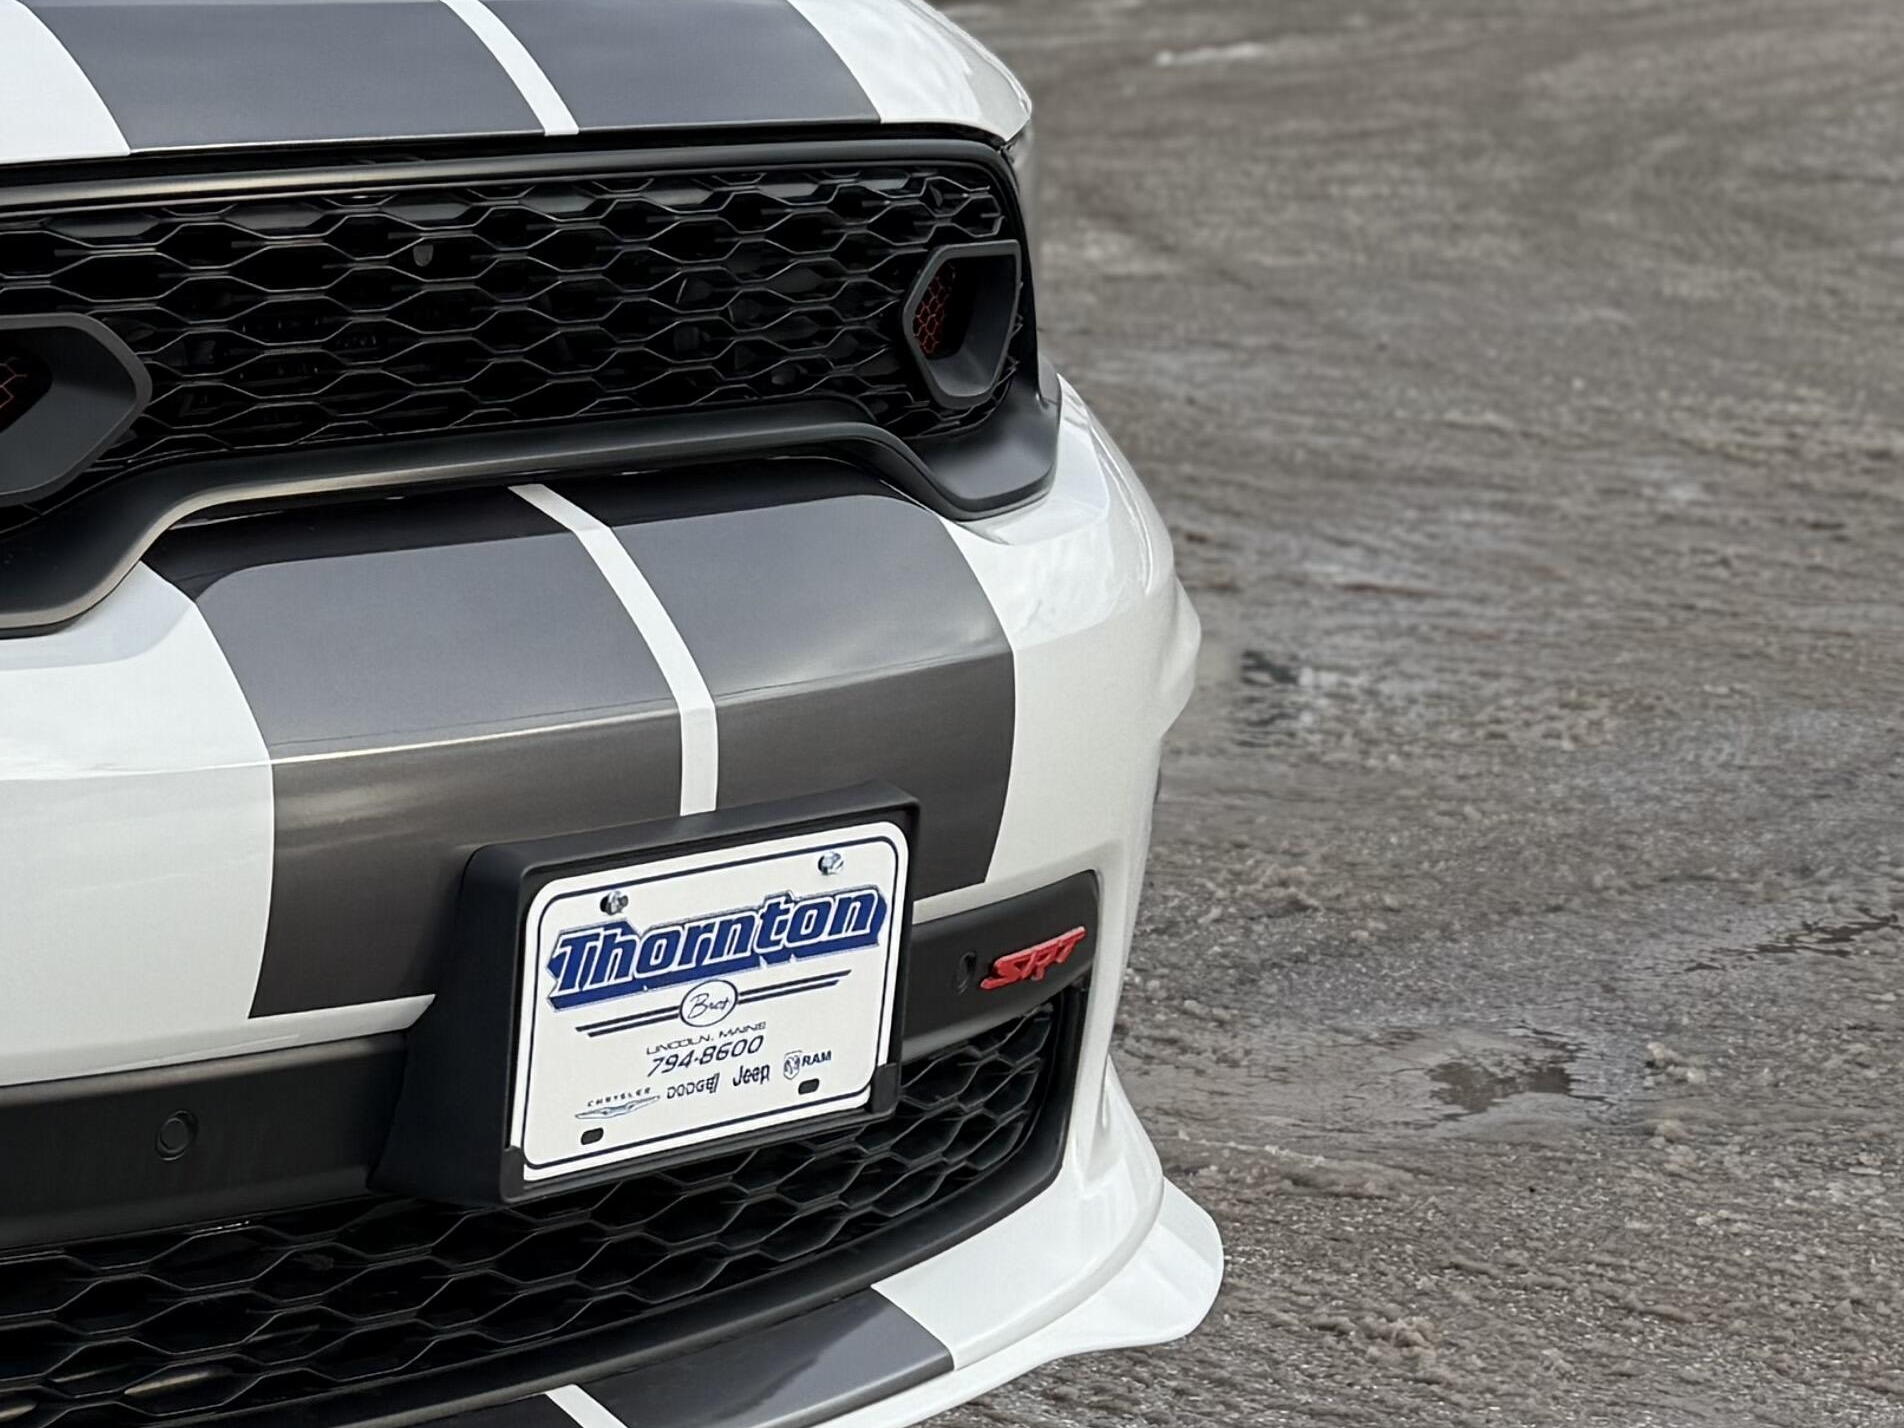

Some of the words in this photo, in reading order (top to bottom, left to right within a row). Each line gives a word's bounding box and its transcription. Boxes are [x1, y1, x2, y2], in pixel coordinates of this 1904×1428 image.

[546, 883, 887, 1012] Thornton
[980, 926, 1086, 991] SRT
[647, 1034, 765, 1078] 794-8600
[719, 1020, 767, 1040] MAINE
[586, 1086, 652, 1108] CHRYSLER
[666, 1075, 714, 1100] DODGE
[732, 1064, 771, 1087] Jeep
[801, 1050, 833, 1068] RAM
